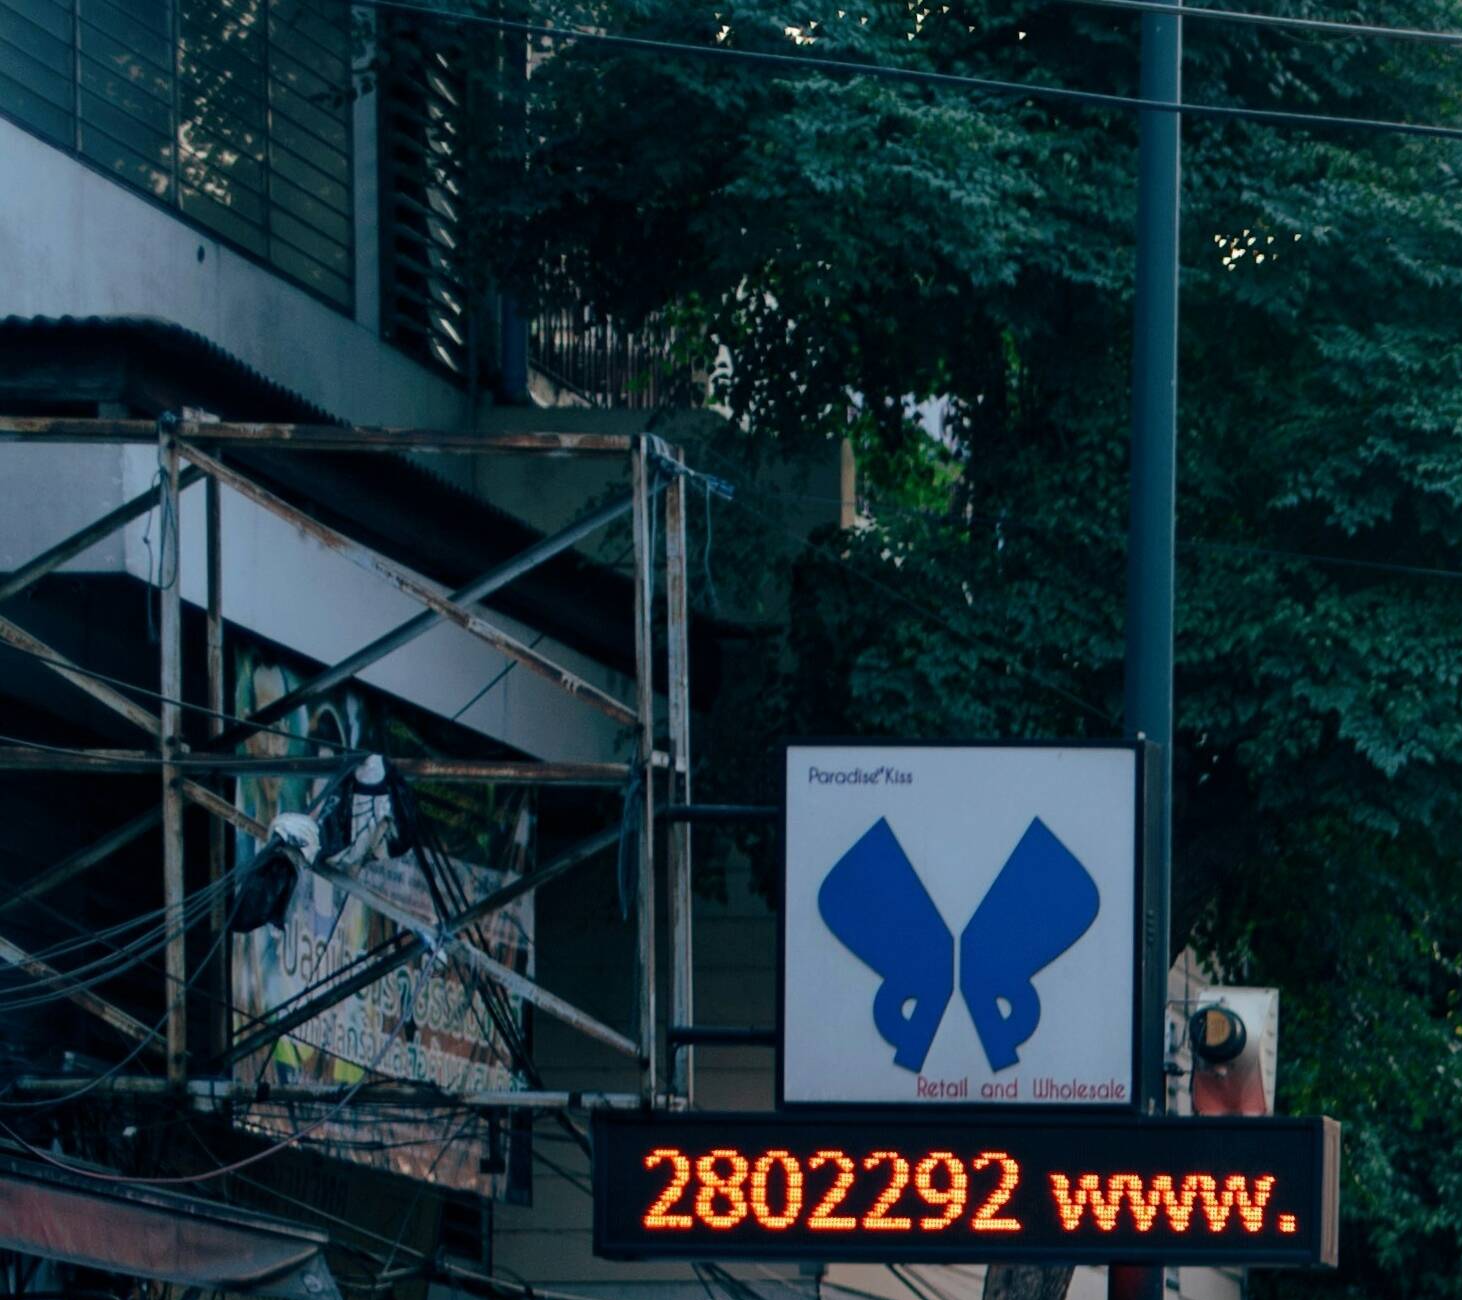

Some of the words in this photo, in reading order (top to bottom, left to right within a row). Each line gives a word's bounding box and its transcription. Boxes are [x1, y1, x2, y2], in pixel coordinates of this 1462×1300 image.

[916, 1075, 969, 1100] Retail
[980, 1075, 1019, 1100] and
[1032, 1076, 1127, 1100] Wholesale
[641, 1148, 1022, 1233] 2802292
[1049, 1172, 1299, 1235] www.
